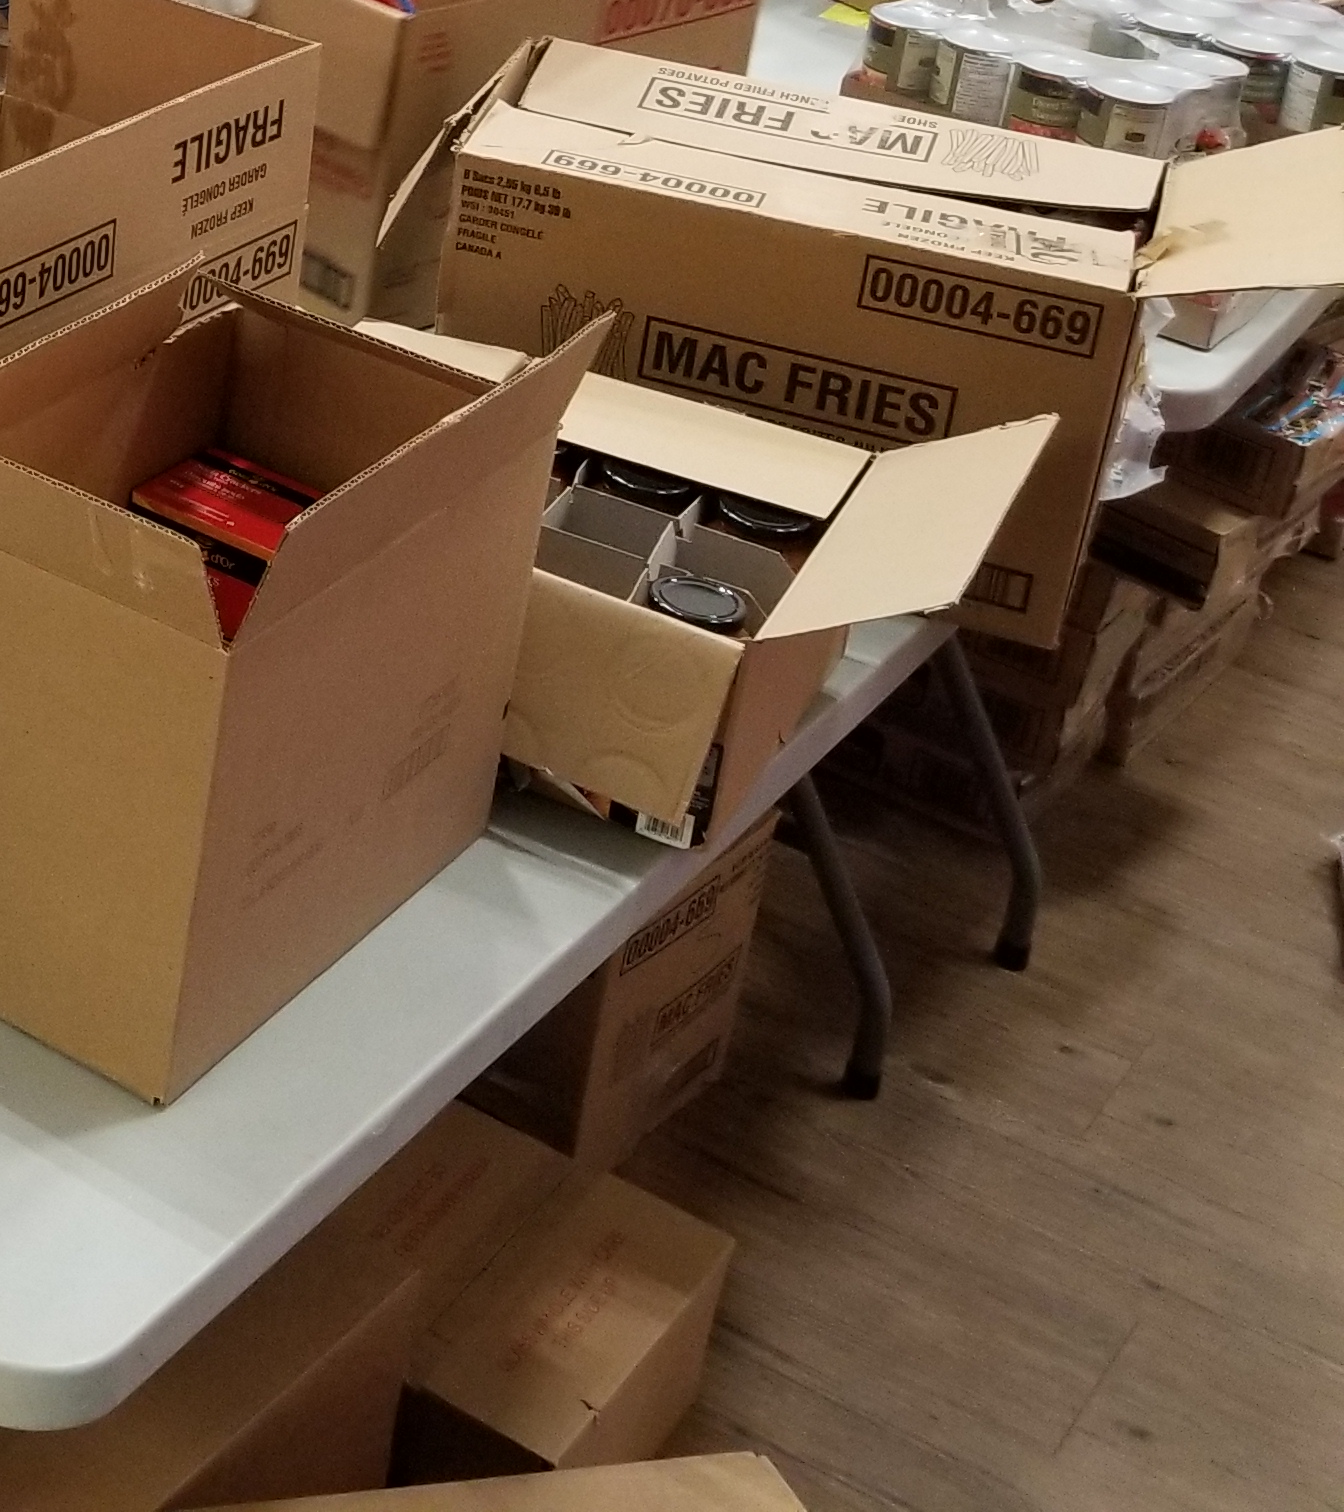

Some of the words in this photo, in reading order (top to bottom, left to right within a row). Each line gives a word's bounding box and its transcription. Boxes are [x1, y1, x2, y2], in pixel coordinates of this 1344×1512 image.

[658, 66, 730, 89] POTATOES
[736, 80, 778, 99] FRIED
[654, 85, 795, 133] FRIES
[170, 99, 285, 185] FRAGILE
[228, 162, 268, 188] GARDER
[552, 152, 756, 205] 00004-669
[181, 179, 227, 217] CONGELÉ
[229, 198, 255, 222] KEEP
[189, 208, 229, 240] FROZEN
[456, 226, 498, 245] FRAGILE
[458, 212, 498, 231] GARDER
[455, 241, 494, 259] CANADA
[896, 231, 967, 253] FROZEN
[869, 266, 1092, 346] 00004-669
[651, 329, 768, 395] MAC
[783, 361, 940, 438] FRIES
